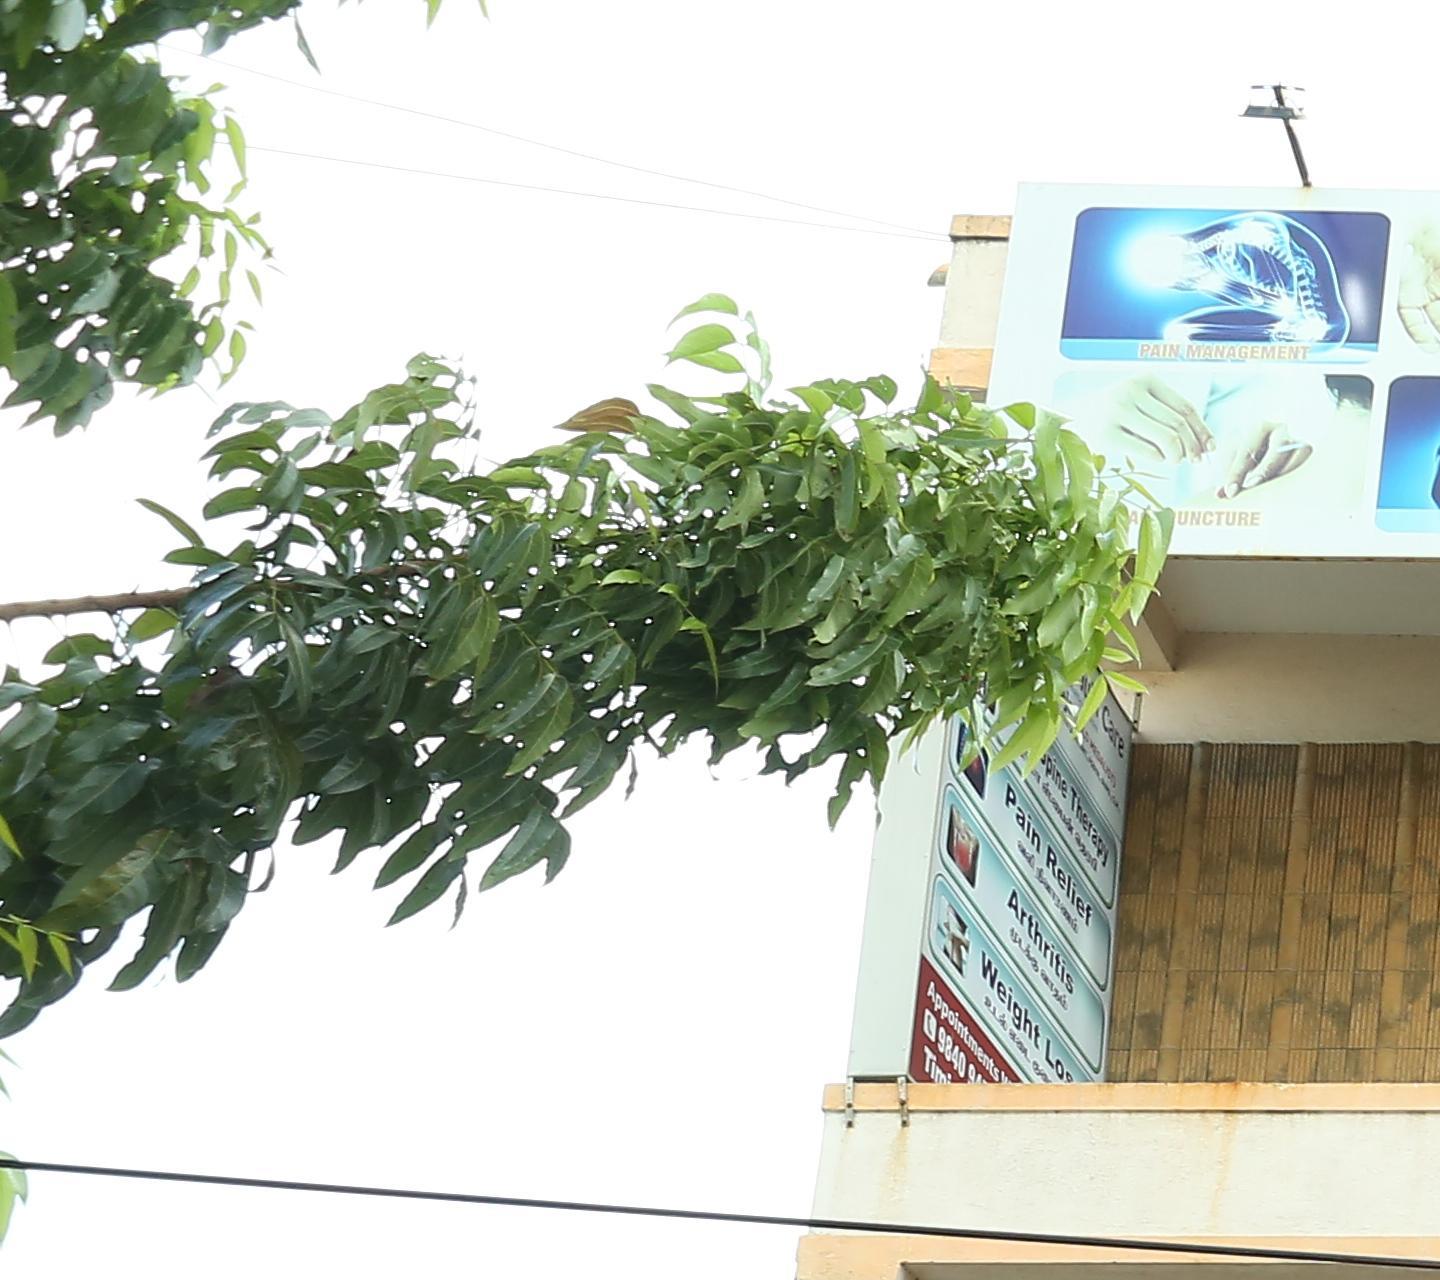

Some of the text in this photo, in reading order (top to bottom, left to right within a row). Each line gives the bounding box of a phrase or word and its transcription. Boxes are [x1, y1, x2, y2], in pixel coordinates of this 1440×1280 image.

[1139, 343, 1310, 361] PAIN MANAGEMENT
[1005, 783, 1042, 855] Pain
[1046, 844, 1094, 927] Relief
[1007, 887, 1074, 995] Arthritis
[981, 951, 1041, 1050] Weight
